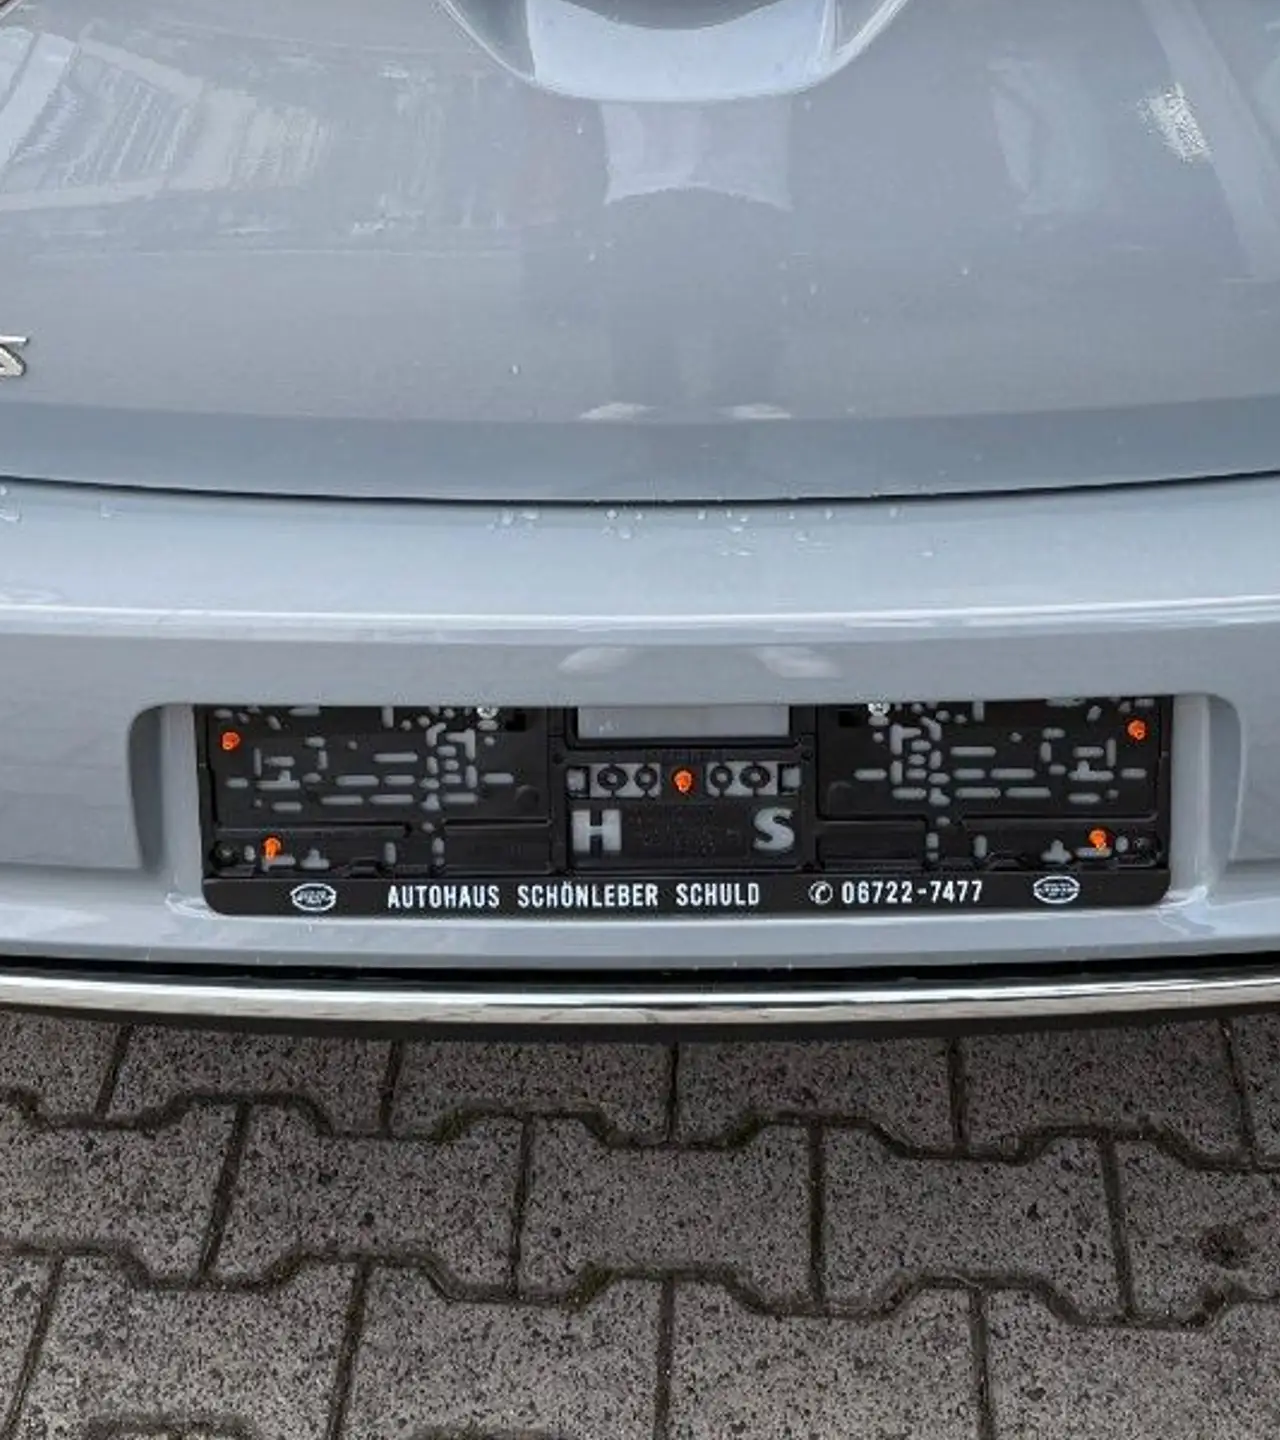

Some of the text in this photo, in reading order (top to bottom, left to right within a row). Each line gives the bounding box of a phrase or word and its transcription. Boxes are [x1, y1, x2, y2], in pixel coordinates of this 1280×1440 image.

[387, 879, 984, 909] AUTOHAUS SCHÖNLEBER SCHULD 06722-7477
